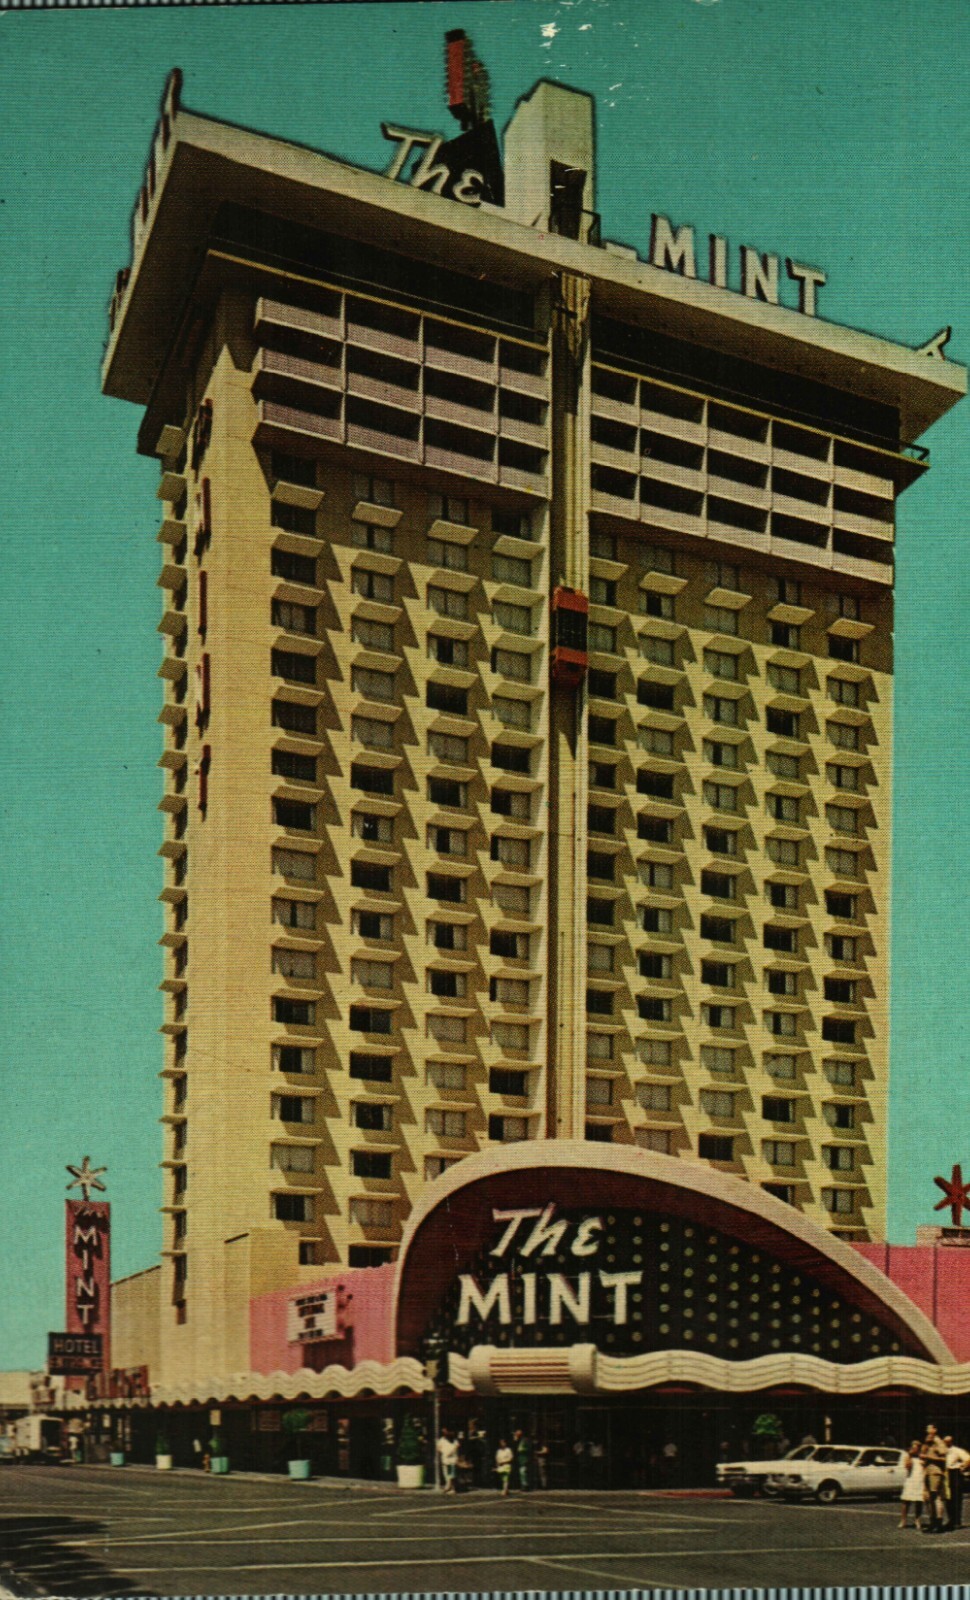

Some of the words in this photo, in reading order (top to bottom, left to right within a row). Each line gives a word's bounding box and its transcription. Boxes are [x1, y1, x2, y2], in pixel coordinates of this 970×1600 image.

[380, 121, 485, 208] The
[649, 212, 827, 318] MINT
[489, 1201, 604, 1258] The
[73, 1224, 99, 1326] MINT
[454, 1269, 644, 1326] MINT
[53, 1338, 99, 1354] HOTEL
